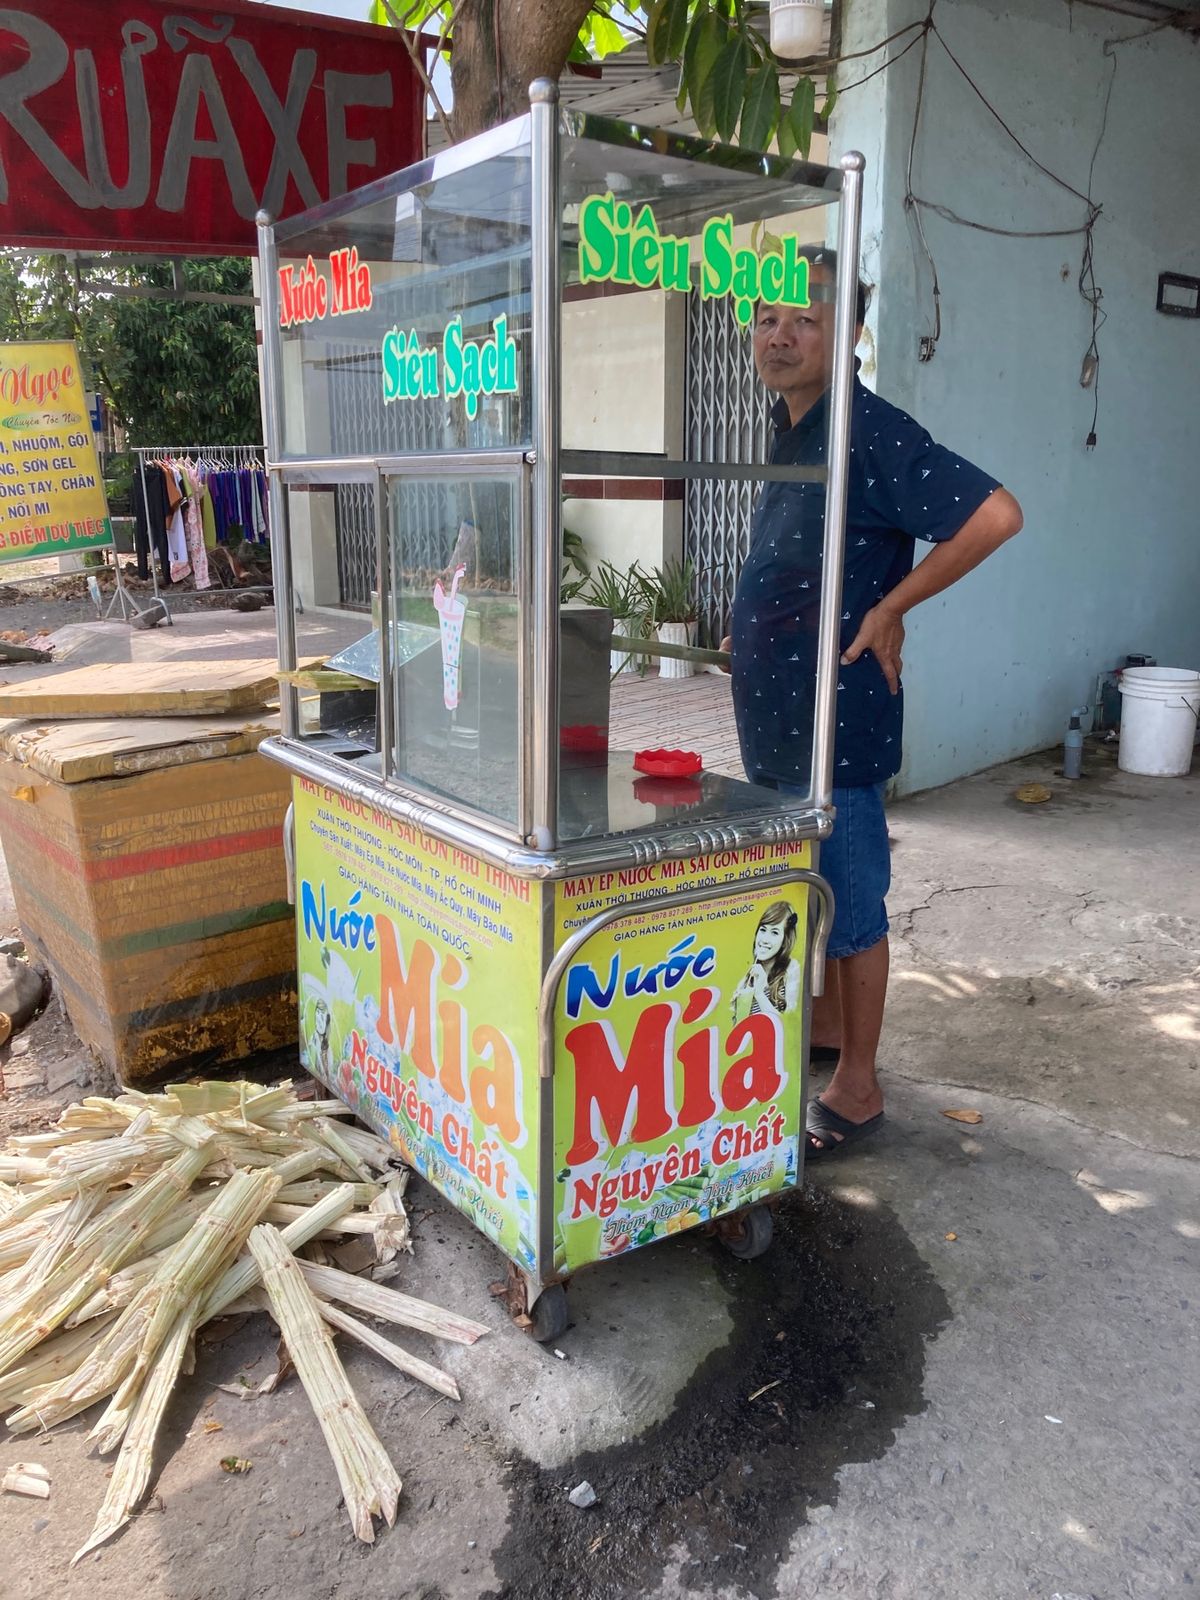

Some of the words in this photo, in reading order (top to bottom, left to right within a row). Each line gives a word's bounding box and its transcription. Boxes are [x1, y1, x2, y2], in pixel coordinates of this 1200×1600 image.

[329, 245, 373, 317] Mía
[579, 191, 692, 293] Siêu
[701, 213, 811, 326] Sạch
[1, 363, 76, 407] Ngọc
[382, 325, 439, 405] Siêu
[443, 313, 518, 421] Sạch
[23, 458, 49, 473] SƠN
[52, 457, 77, 470] GEL
[61, 475, 96, 491] CHÂN
[8, 499, 31, 518] NỐI
[35, 502, 51, 515] MI
[301, 880, 376, 952] Nước
[338, 865, 357, 885] GIAO
[442, 929, 470, 955] QUỐC
[478, 891, 503, 915] MINH
[576, 898, 603, 912] XUÂN
[769, 861, 791, 874] MINH
[613, 929, 638, 942] GIAO
[565, 932, 717, 1019] Nước
[375, 914, 523, 1144] Mía
[565, 987, 786, 1167] Mía
[350, 1029, 434, 1137] Nguyên
[442, 1112, 509, 1200] Chất
[570, 1143, 702, 1220] Nguyên
[710, 1104, 786, 1167] Chất
[651, 1198, 691, 1221] Ngon
